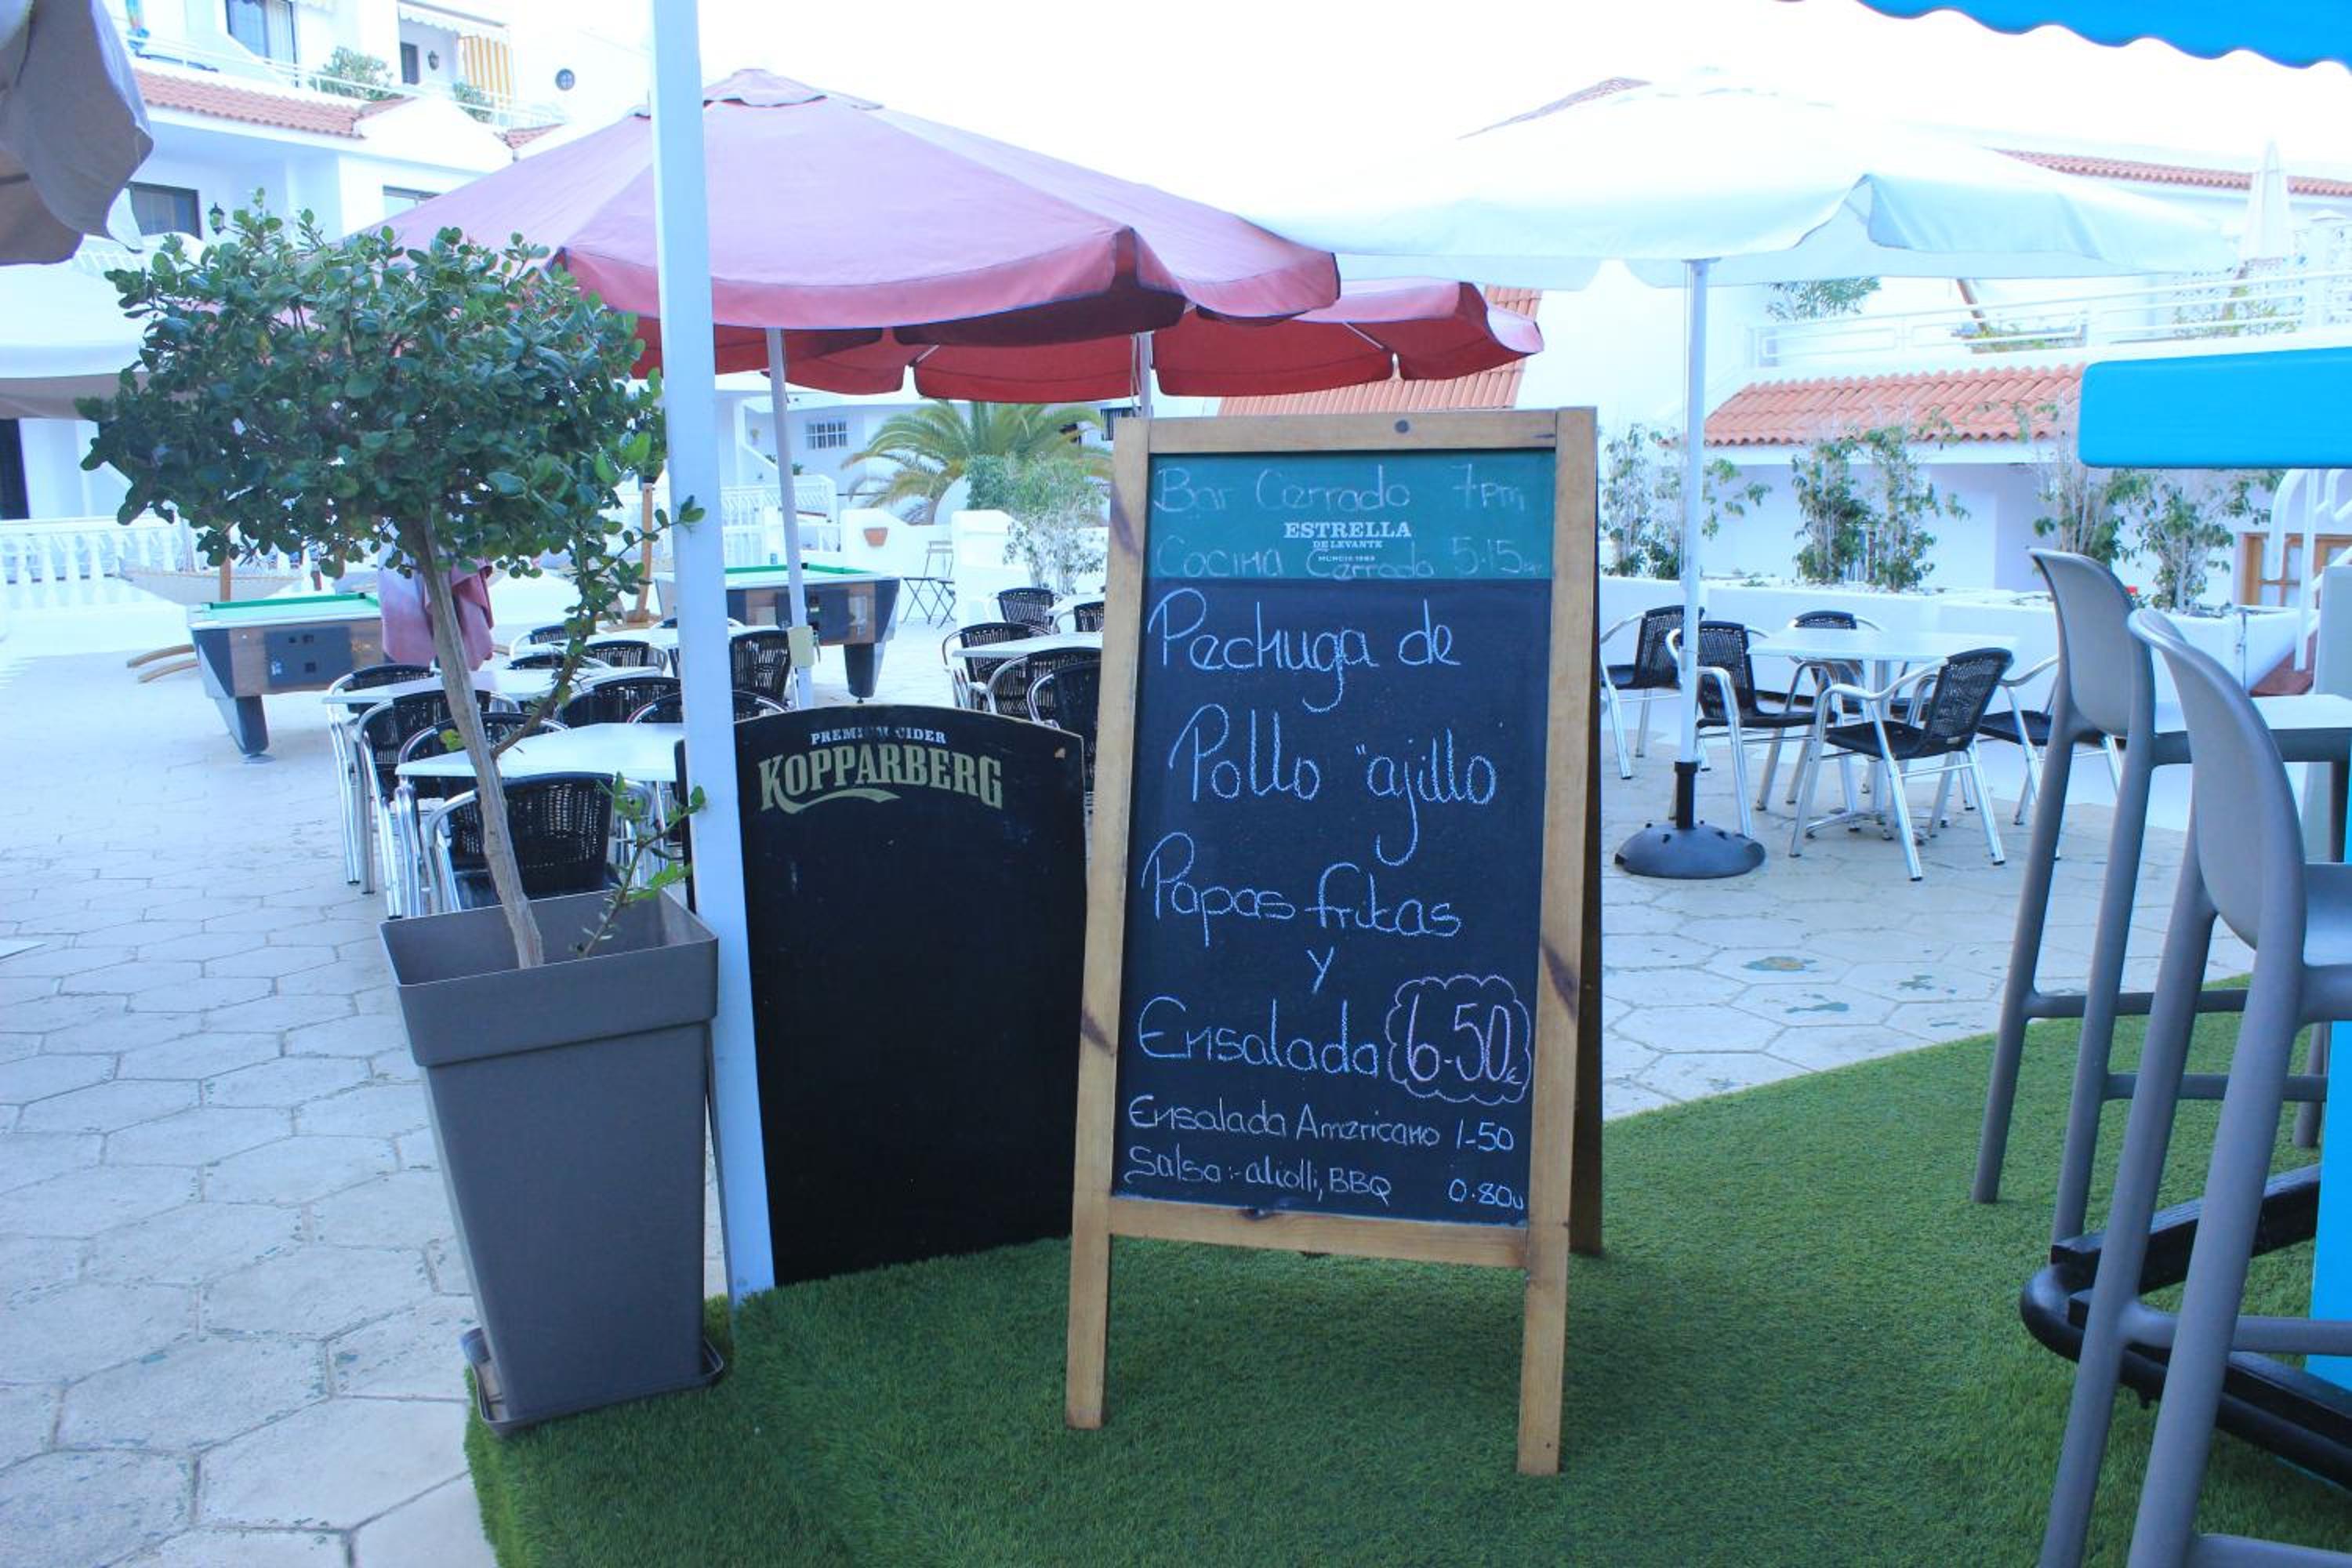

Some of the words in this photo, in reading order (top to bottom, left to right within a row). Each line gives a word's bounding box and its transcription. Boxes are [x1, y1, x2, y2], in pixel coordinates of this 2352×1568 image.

[1155, 466, 1230, 512] Bar
[1283, 521, 1412, 539] ESTRELLA
[1330, 539, 1383, 549] LEVANTE
[1147, 587, 1380, 713] Pechuga
[1398, 599, 1462, 666] de
[758, 743, 1004, 814] KOPPARBERG
[1168, 704, 1321, 803] Pollo
[1141, 832, 1295, 947] Papas
[1305, 862, 1461, 937] fritas
[1138, 996, 1378, 1078] Ensalada
[1128, 1094, 1287, 1137] Ensalada
[1295, 1103, 1440, 1147] Americano
[1329, 1167, 1392, 1207] BBQ
